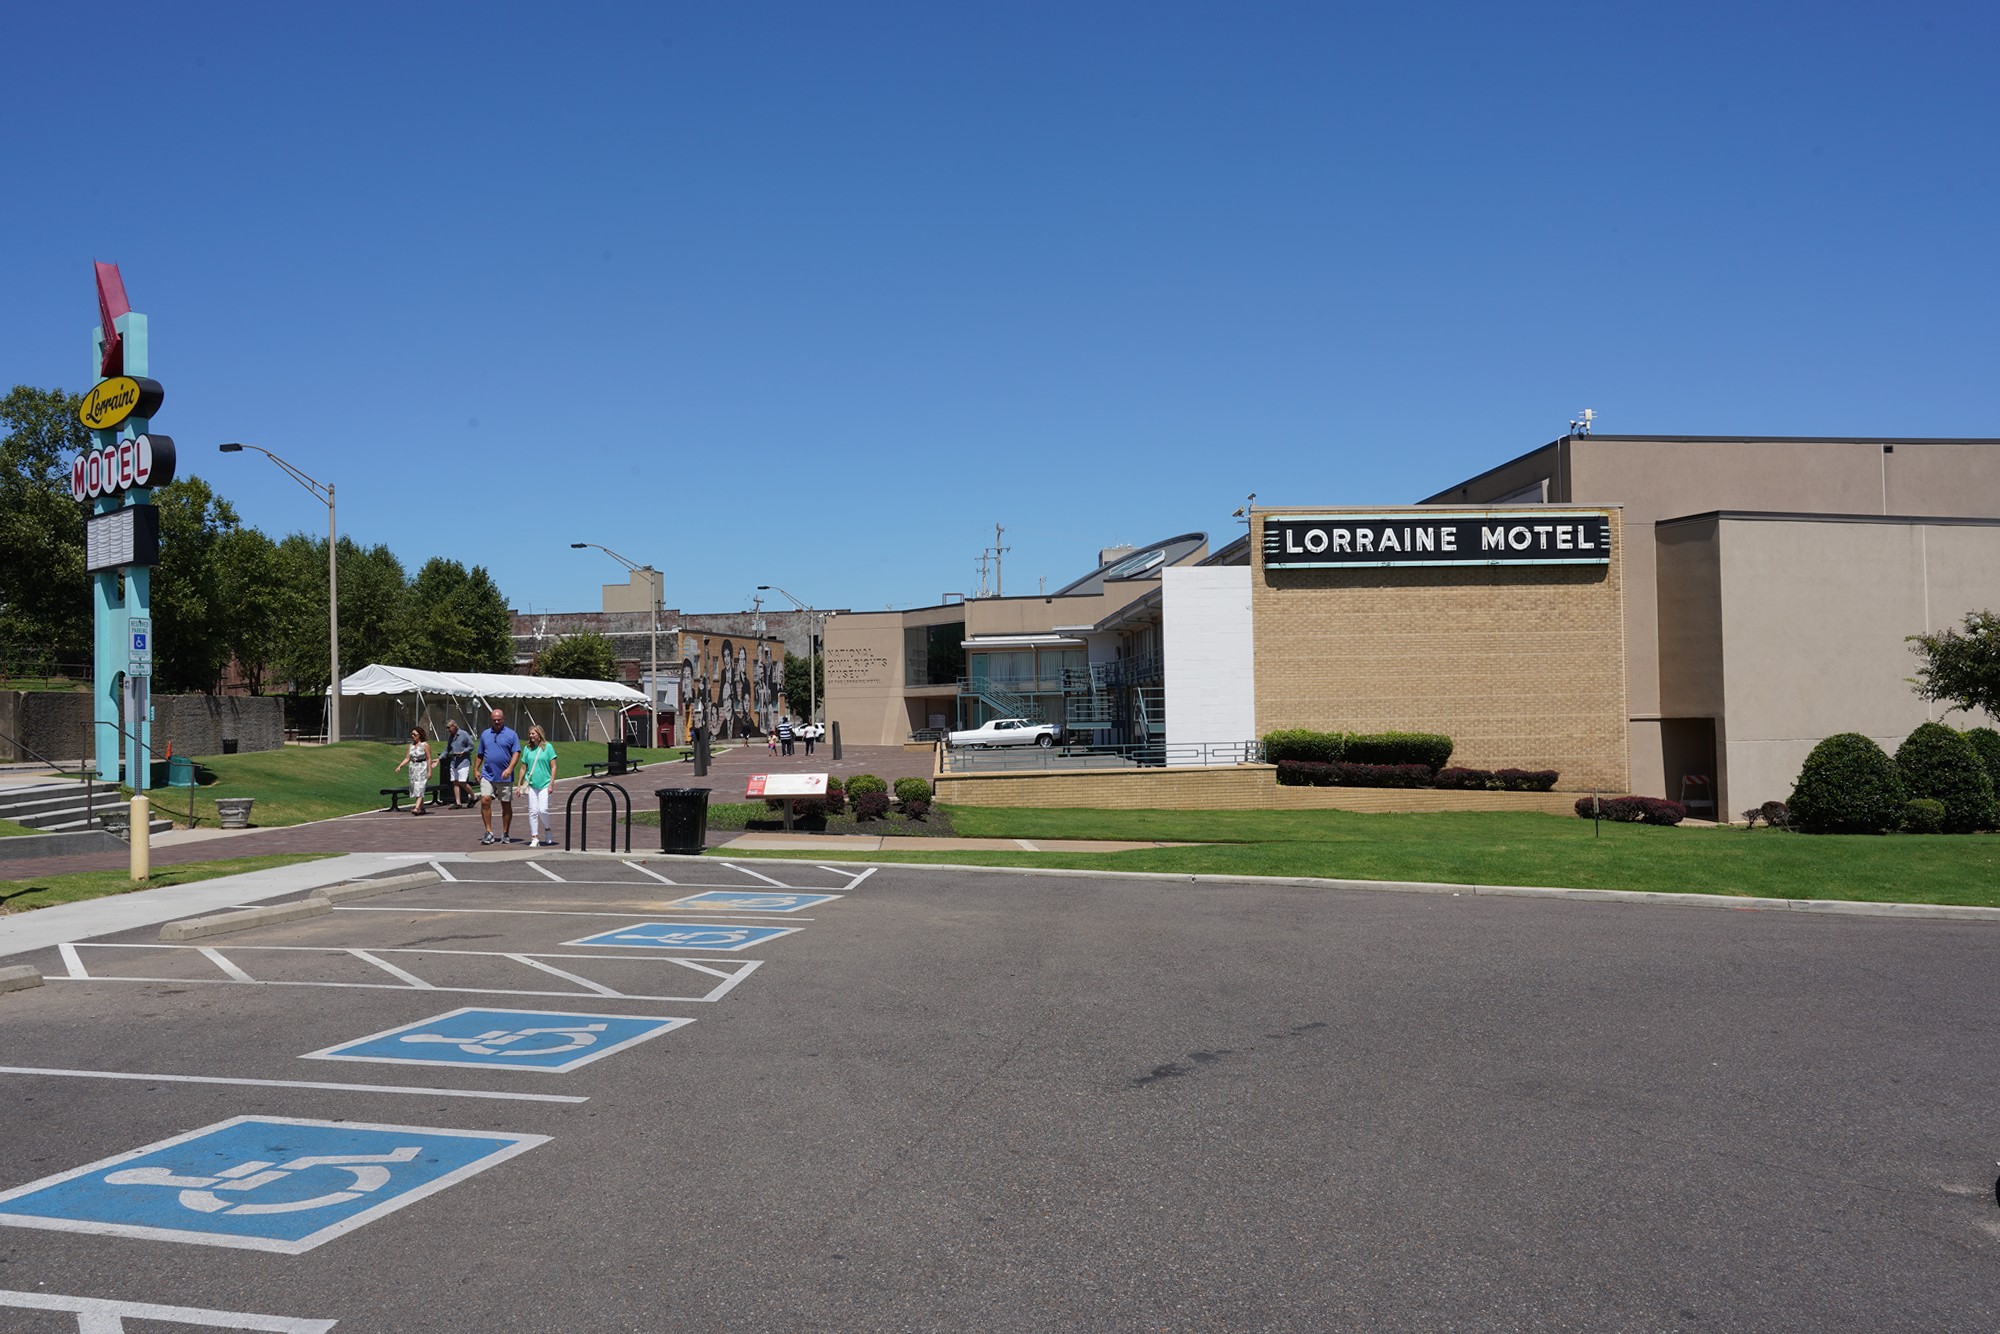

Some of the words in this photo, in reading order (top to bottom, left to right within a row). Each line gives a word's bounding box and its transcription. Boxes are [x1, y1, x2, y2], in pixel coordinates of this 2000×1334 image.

[85, 384, 135, 424] Lorraine
[74, 442, 148, 495] MOTEL
[1285, 526, 1458, 554] LORRAINE
[1481, 524, 1595, 551] MOTEL
